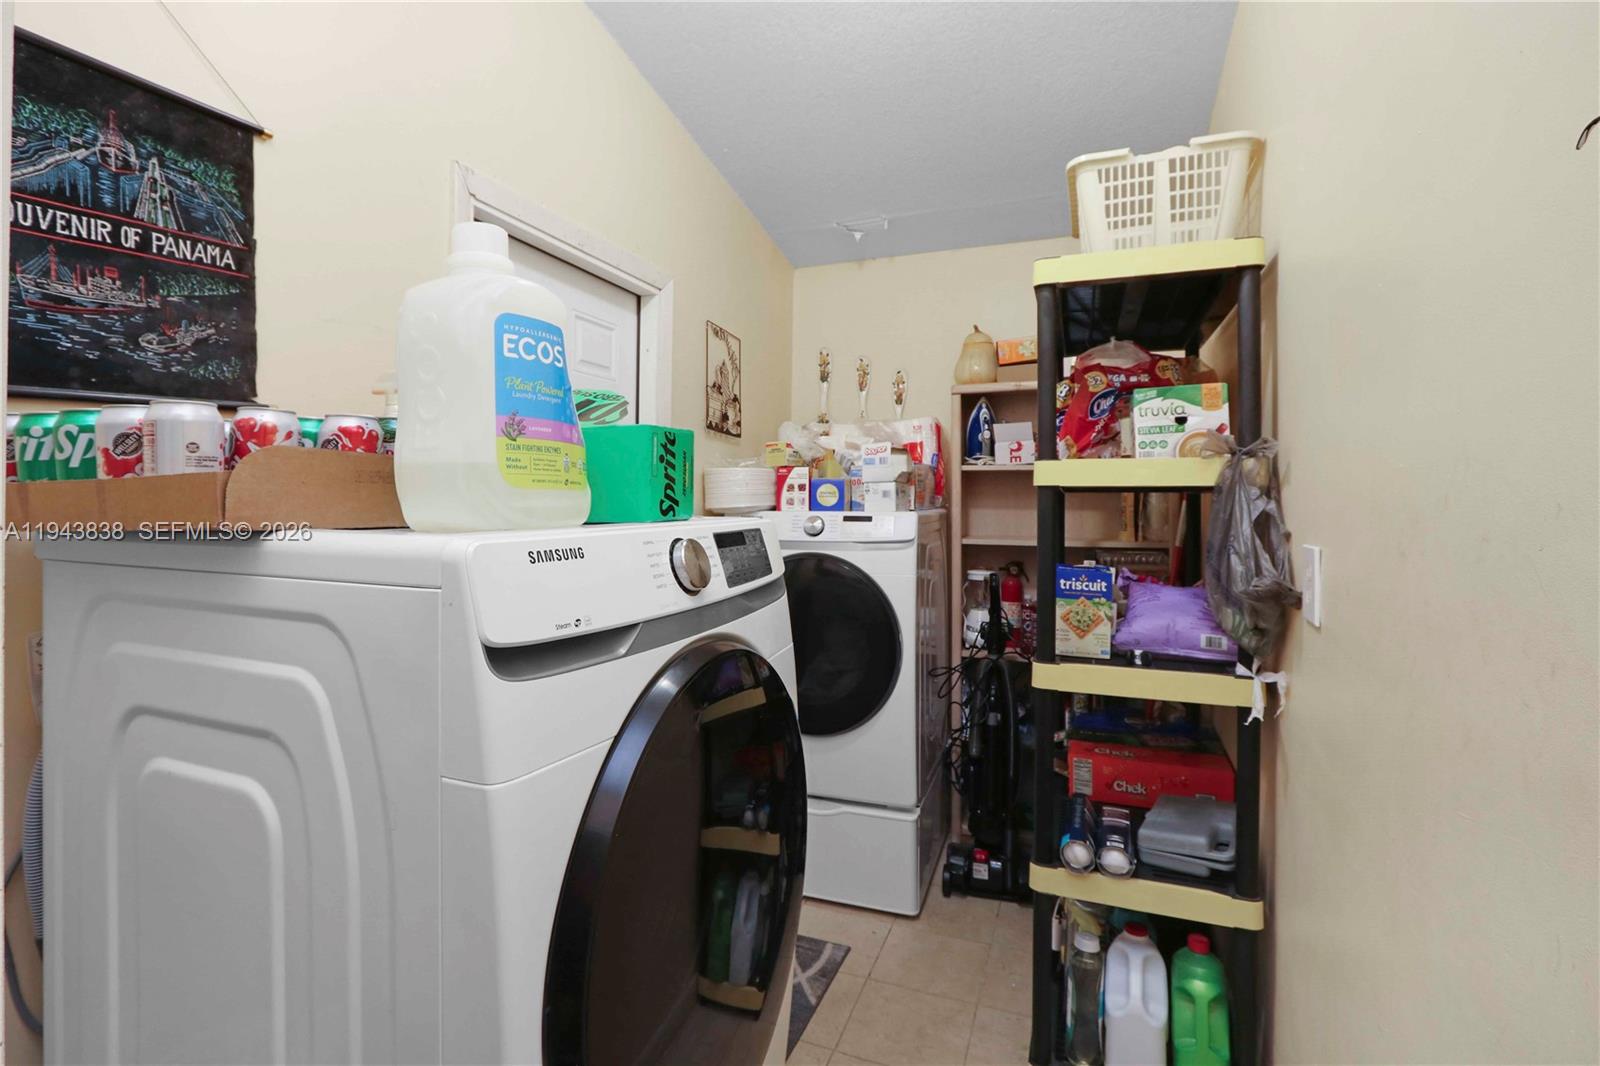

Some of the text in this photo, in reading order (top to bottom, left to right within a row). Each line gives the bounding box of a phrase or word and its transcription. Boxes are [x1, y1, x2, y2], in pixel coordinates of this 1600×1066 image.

[120, 226, 142, 249] OF
[151, 231, 237, 271] PANAMA
[503, 333, 564, 368] ECOS
[659, 431, 680, 518] Sprite
[528, 547, 585, 564] SAMSUNG
[1060, 578, 1107, 592] triscuit
[1113, 780, 1146, 794] Chek
